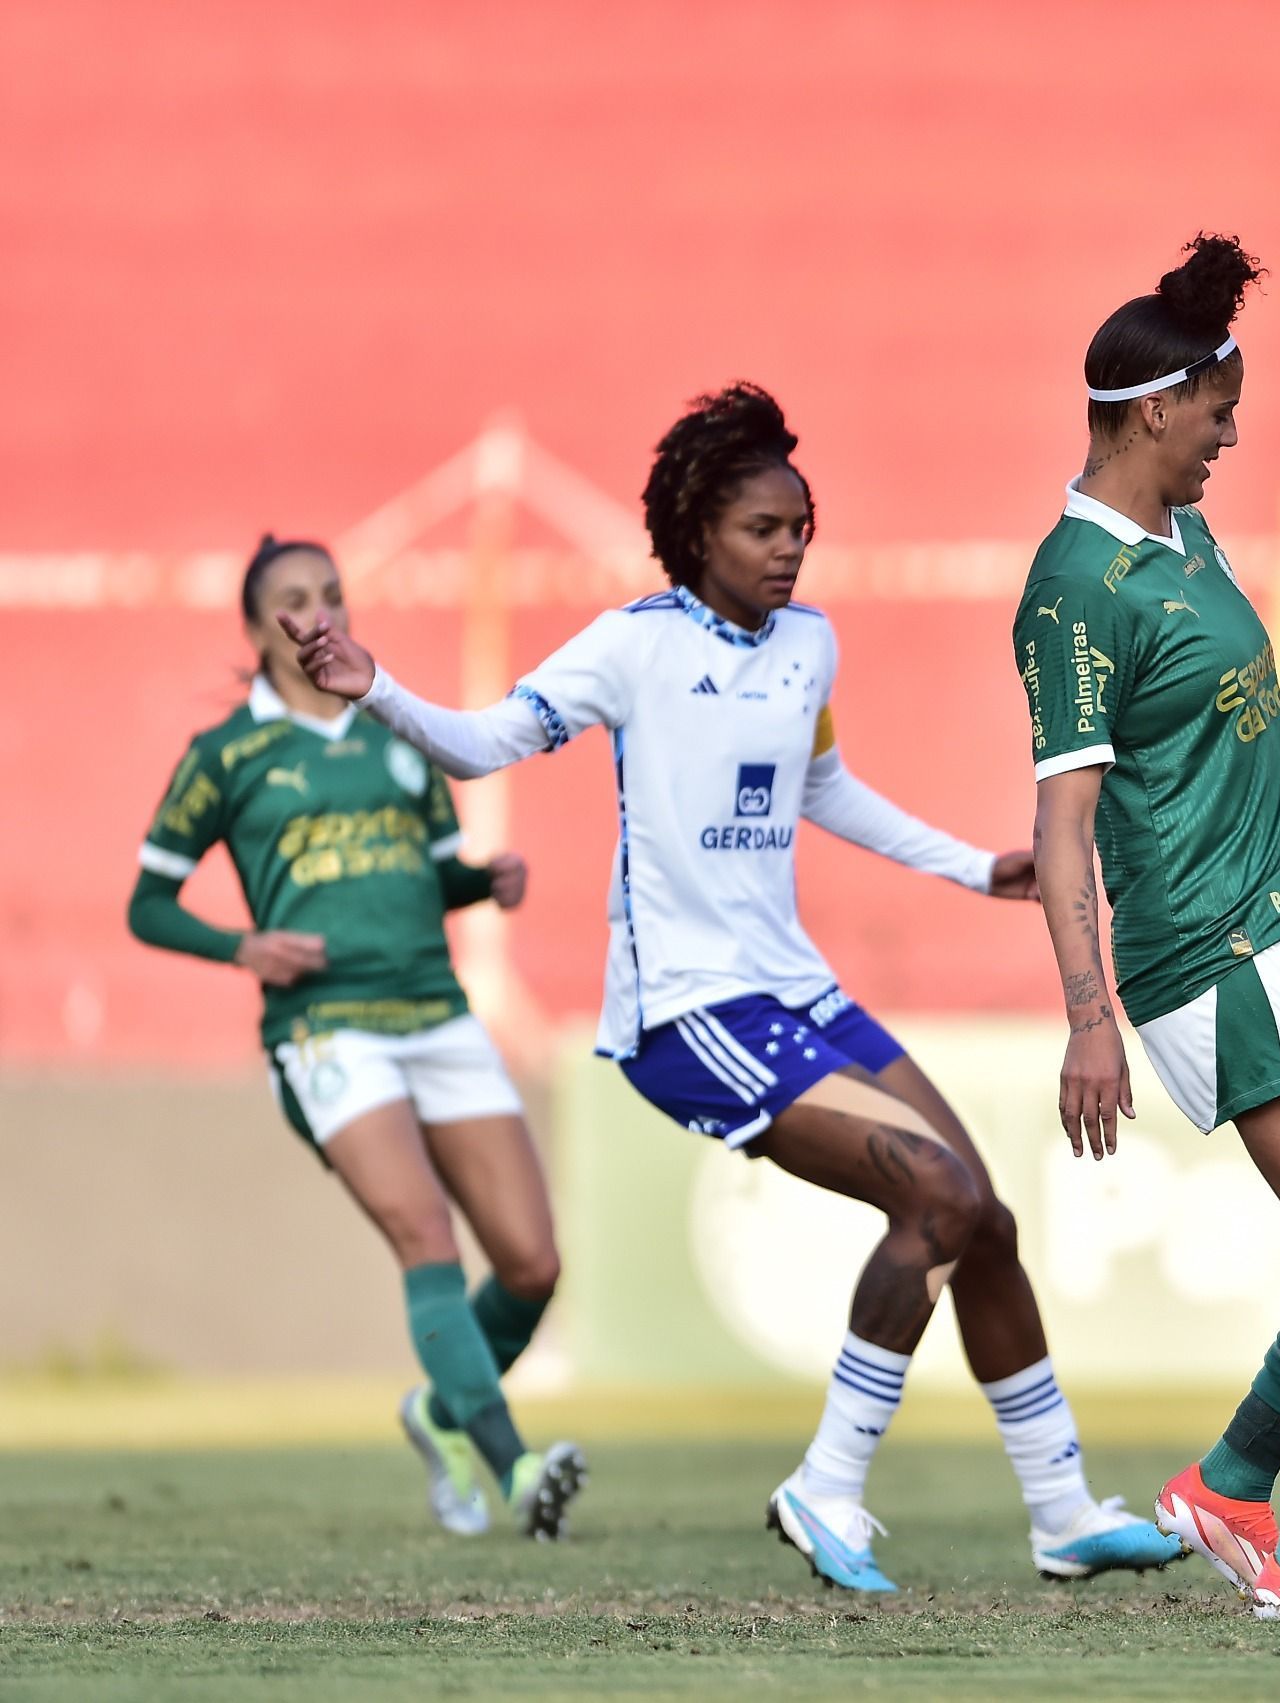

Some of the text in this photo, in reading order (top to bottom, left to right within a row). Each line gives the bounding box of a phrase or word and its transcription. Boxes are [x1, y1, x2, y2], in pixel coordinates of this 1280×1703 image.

[1026, 640, 1047, 750] Palmiras
[1071, 621, 1096, 733] Palmeiras
[1236, 705, 1267, 742] da
[700, 825, 793, 850] GERDAU
